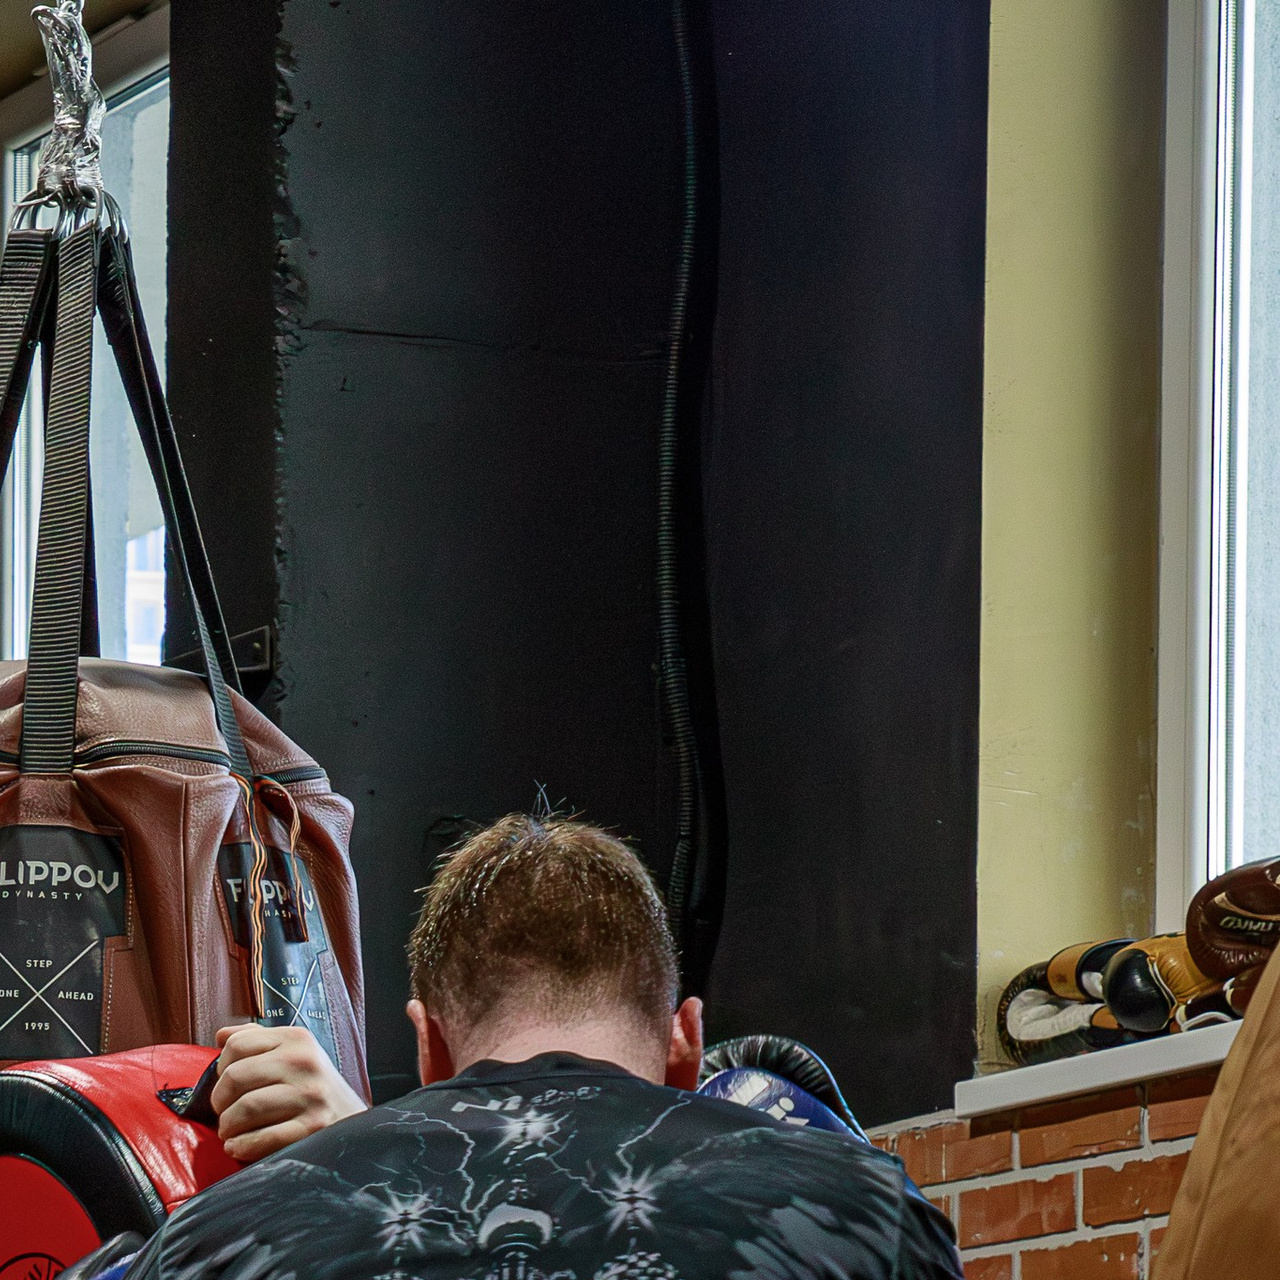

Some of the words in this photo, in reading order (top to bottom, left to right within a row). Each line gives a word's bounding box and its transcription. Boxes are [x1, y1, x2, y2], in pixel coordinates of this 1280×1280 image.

[2, 889, 84, 901] DYNASTY
[25, 959, 53, 969] STEP
[57, 990, 95, 1001] AHEAD
[266, 1008, 285, 1018] ONE
[24, 1021, 51, 1031] 1995
